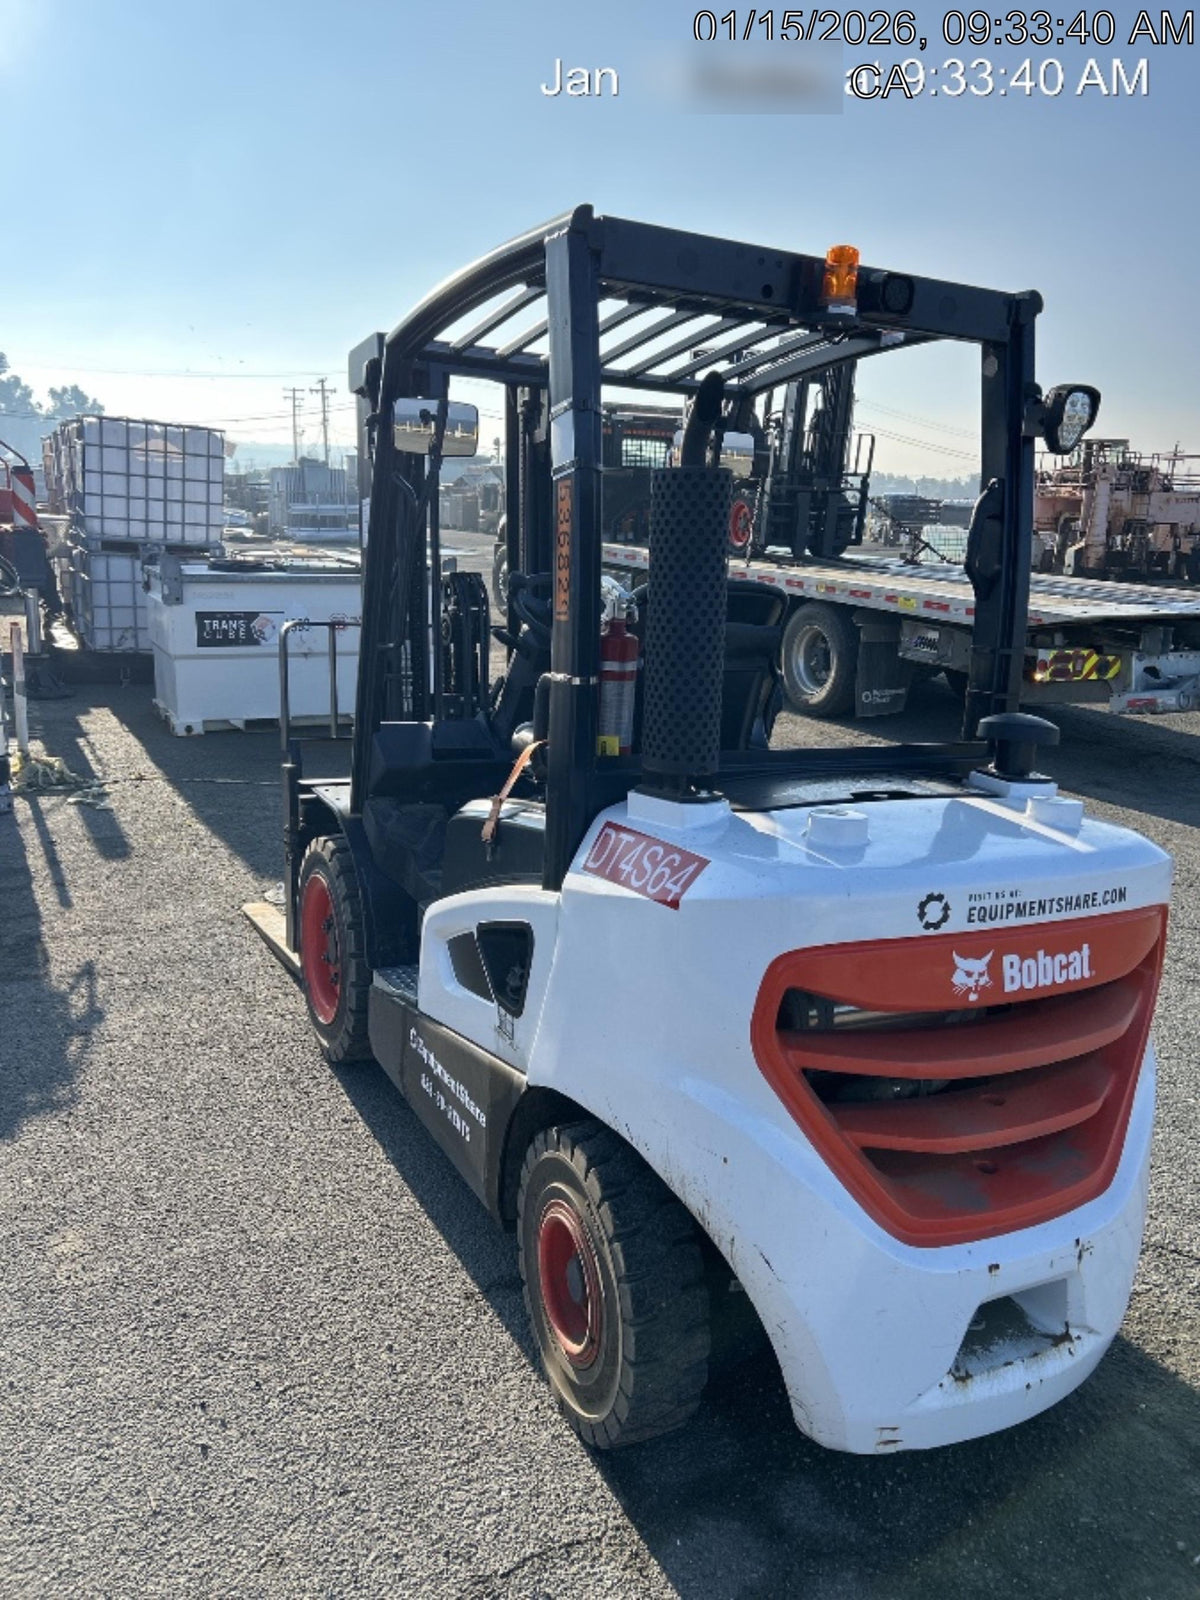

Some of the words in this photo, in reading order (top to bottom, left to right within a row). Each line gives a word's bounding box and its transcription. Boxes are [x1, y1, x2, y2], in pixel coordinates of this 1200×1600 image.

[203, 619, 247, 631] TRANS
[586, 826, 699, 902] DT4S64
[1002, 943, 1090, 993] Bobcat
